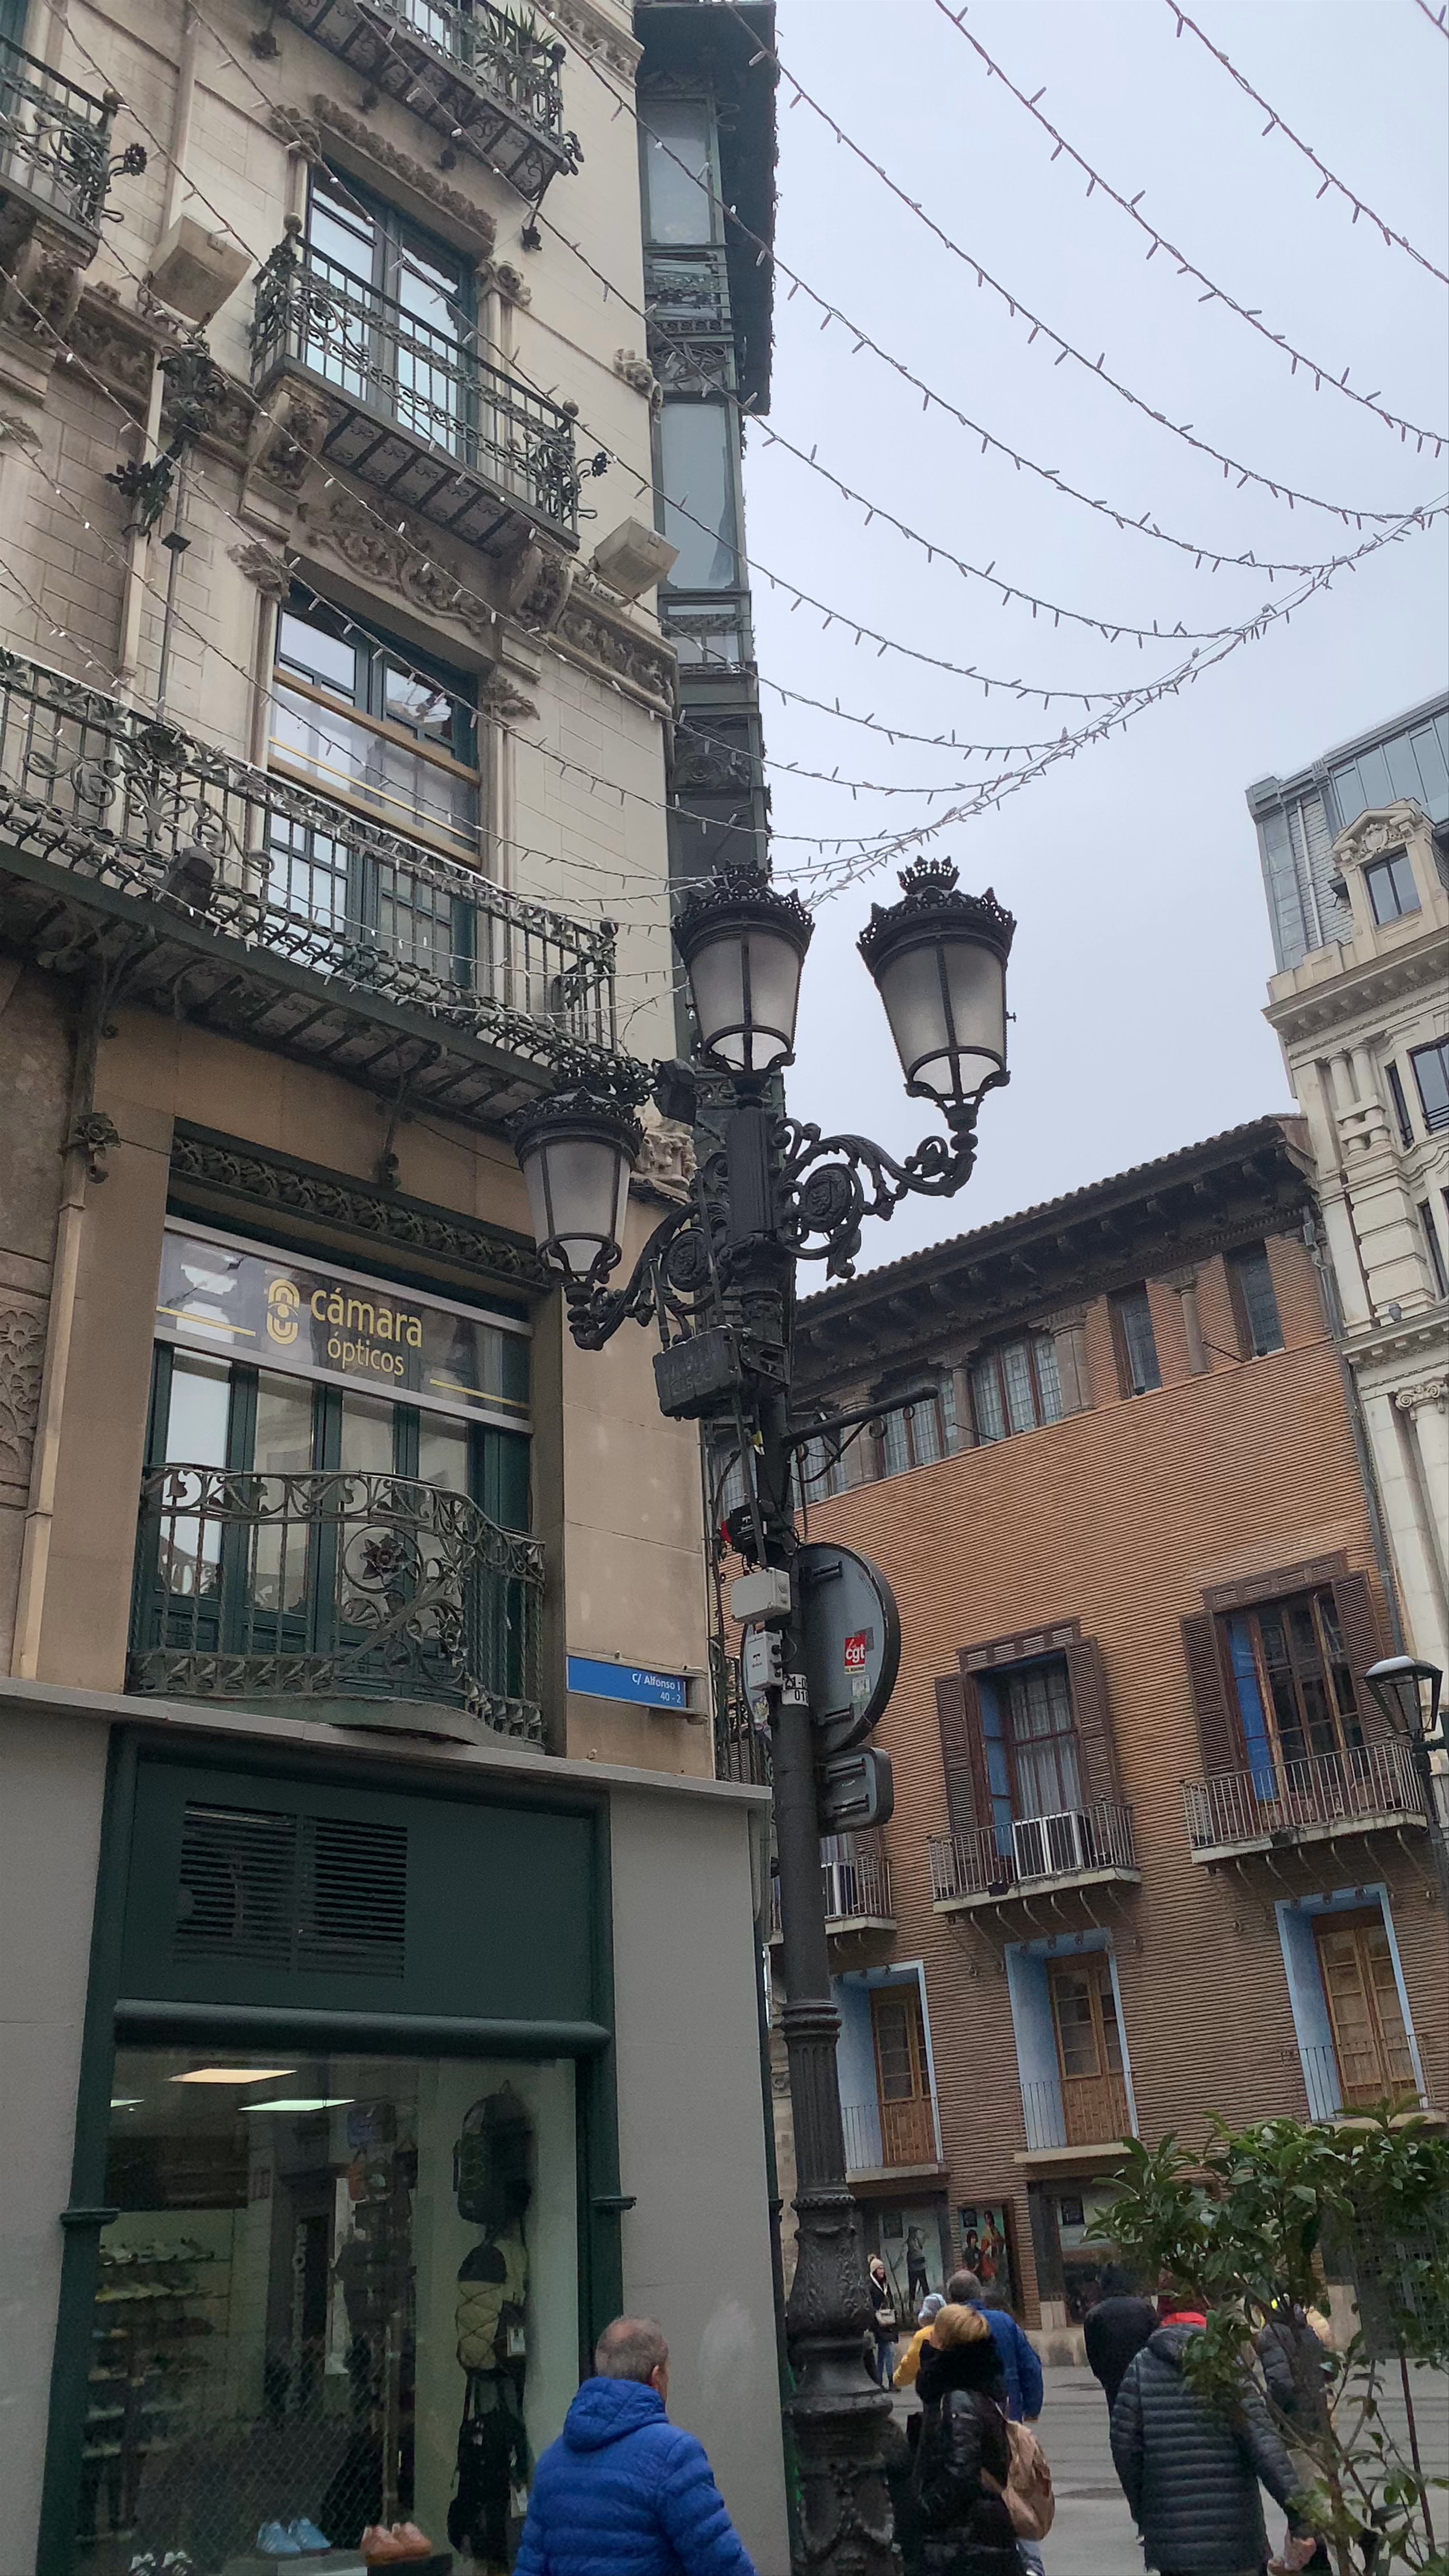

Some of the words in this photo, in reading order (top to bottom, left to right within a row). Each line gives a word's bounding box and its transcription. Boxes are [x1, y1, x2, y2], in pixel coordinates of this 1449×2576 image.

[311, 1287, 423, 1347] cámara
[328, 1331, 404, 1376] ópticos
[846, 1644, 865, 1663] cgt
[632, 1673, 641, 1685] C/
[644, 1675, 675, 1690] Alfonso
[660, 1692, 670, 1701] 40
[676, 1694, 681, 1704] 2
